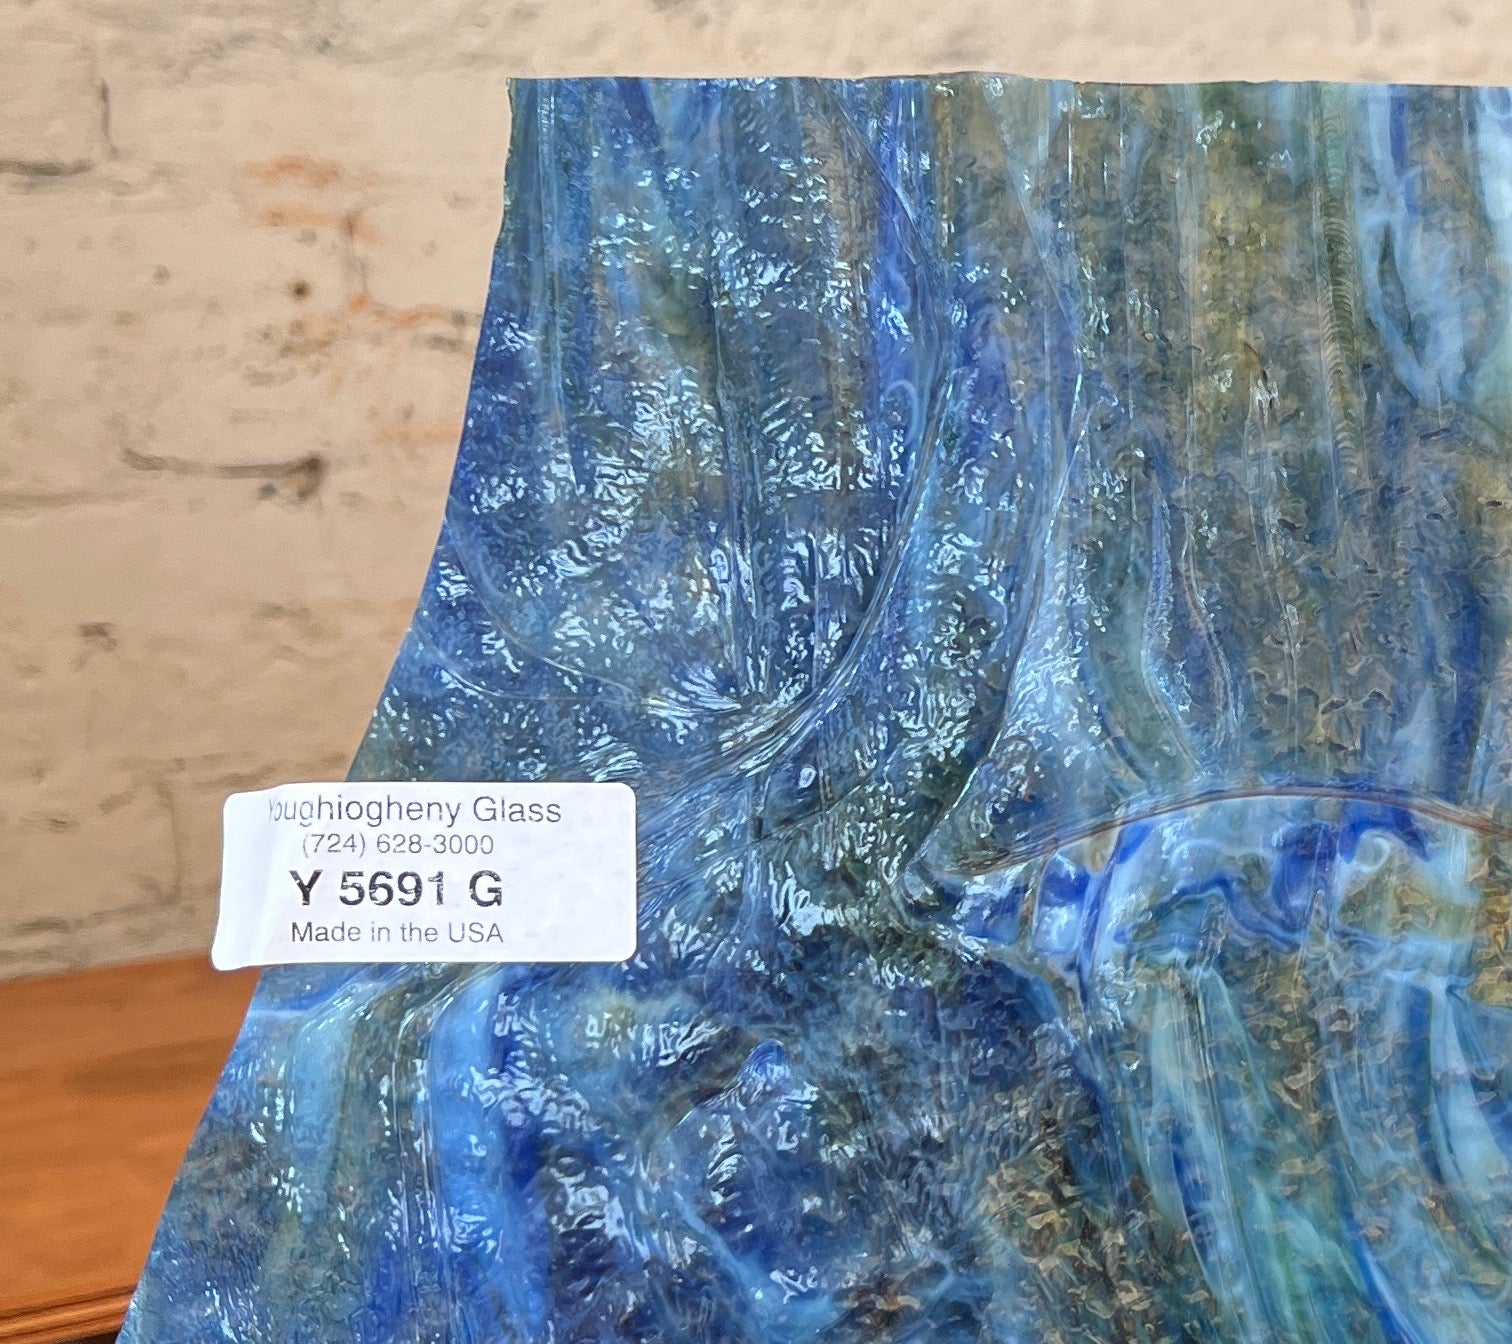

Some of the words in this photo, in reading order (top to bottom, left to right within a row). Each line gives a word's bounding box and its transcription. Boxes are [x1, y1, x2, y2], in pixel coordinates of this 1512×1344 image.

[269, 795, 461, 827] Youghiogheny
[473, 796, 562, 824] Glass
[302, 833, 366, 858] (724)
[377, 833, 494, 855] 628-3000
[289, 870, 324, 906] Y
[339, 870, 445, 907] 5691
[469, 870, 503, 907] G
[291, 922, 361, 943] Made
[371, 922, 391, 943] in
[400, 922, 439, 943] the
[449, 922, 504, 944] USA
